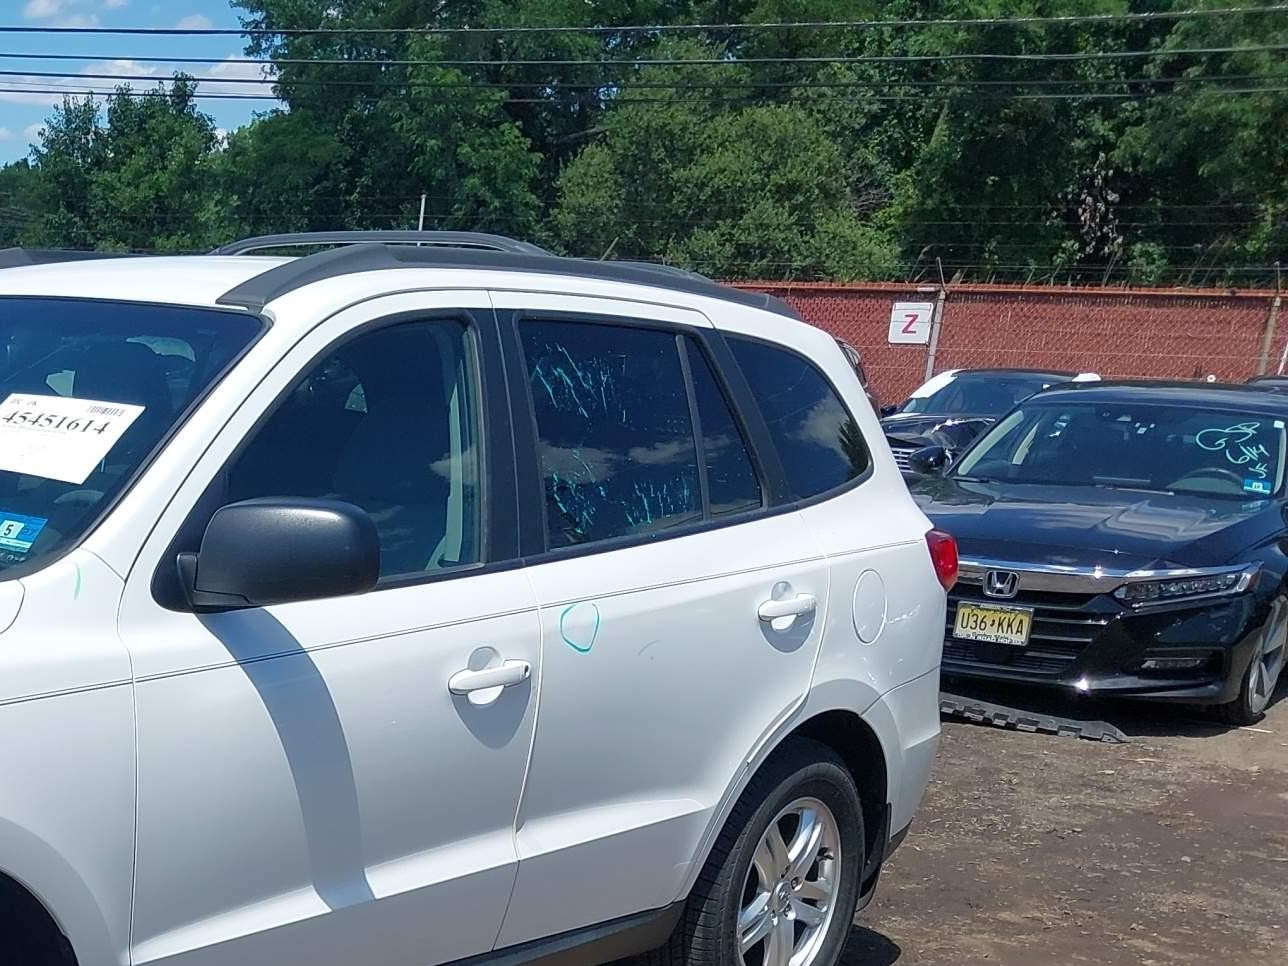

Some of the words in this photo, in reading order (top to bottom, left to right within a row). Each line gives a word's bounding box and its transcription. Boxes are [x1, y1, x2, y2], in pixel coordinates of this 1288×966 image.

[902, 314, 918, 334] Z
[1, 410, 111, 435] 45451614
[4, 524, 14, 536] 5
[960, 612, 987, 632] U36
[996, 616, 1024, 636] KKA
